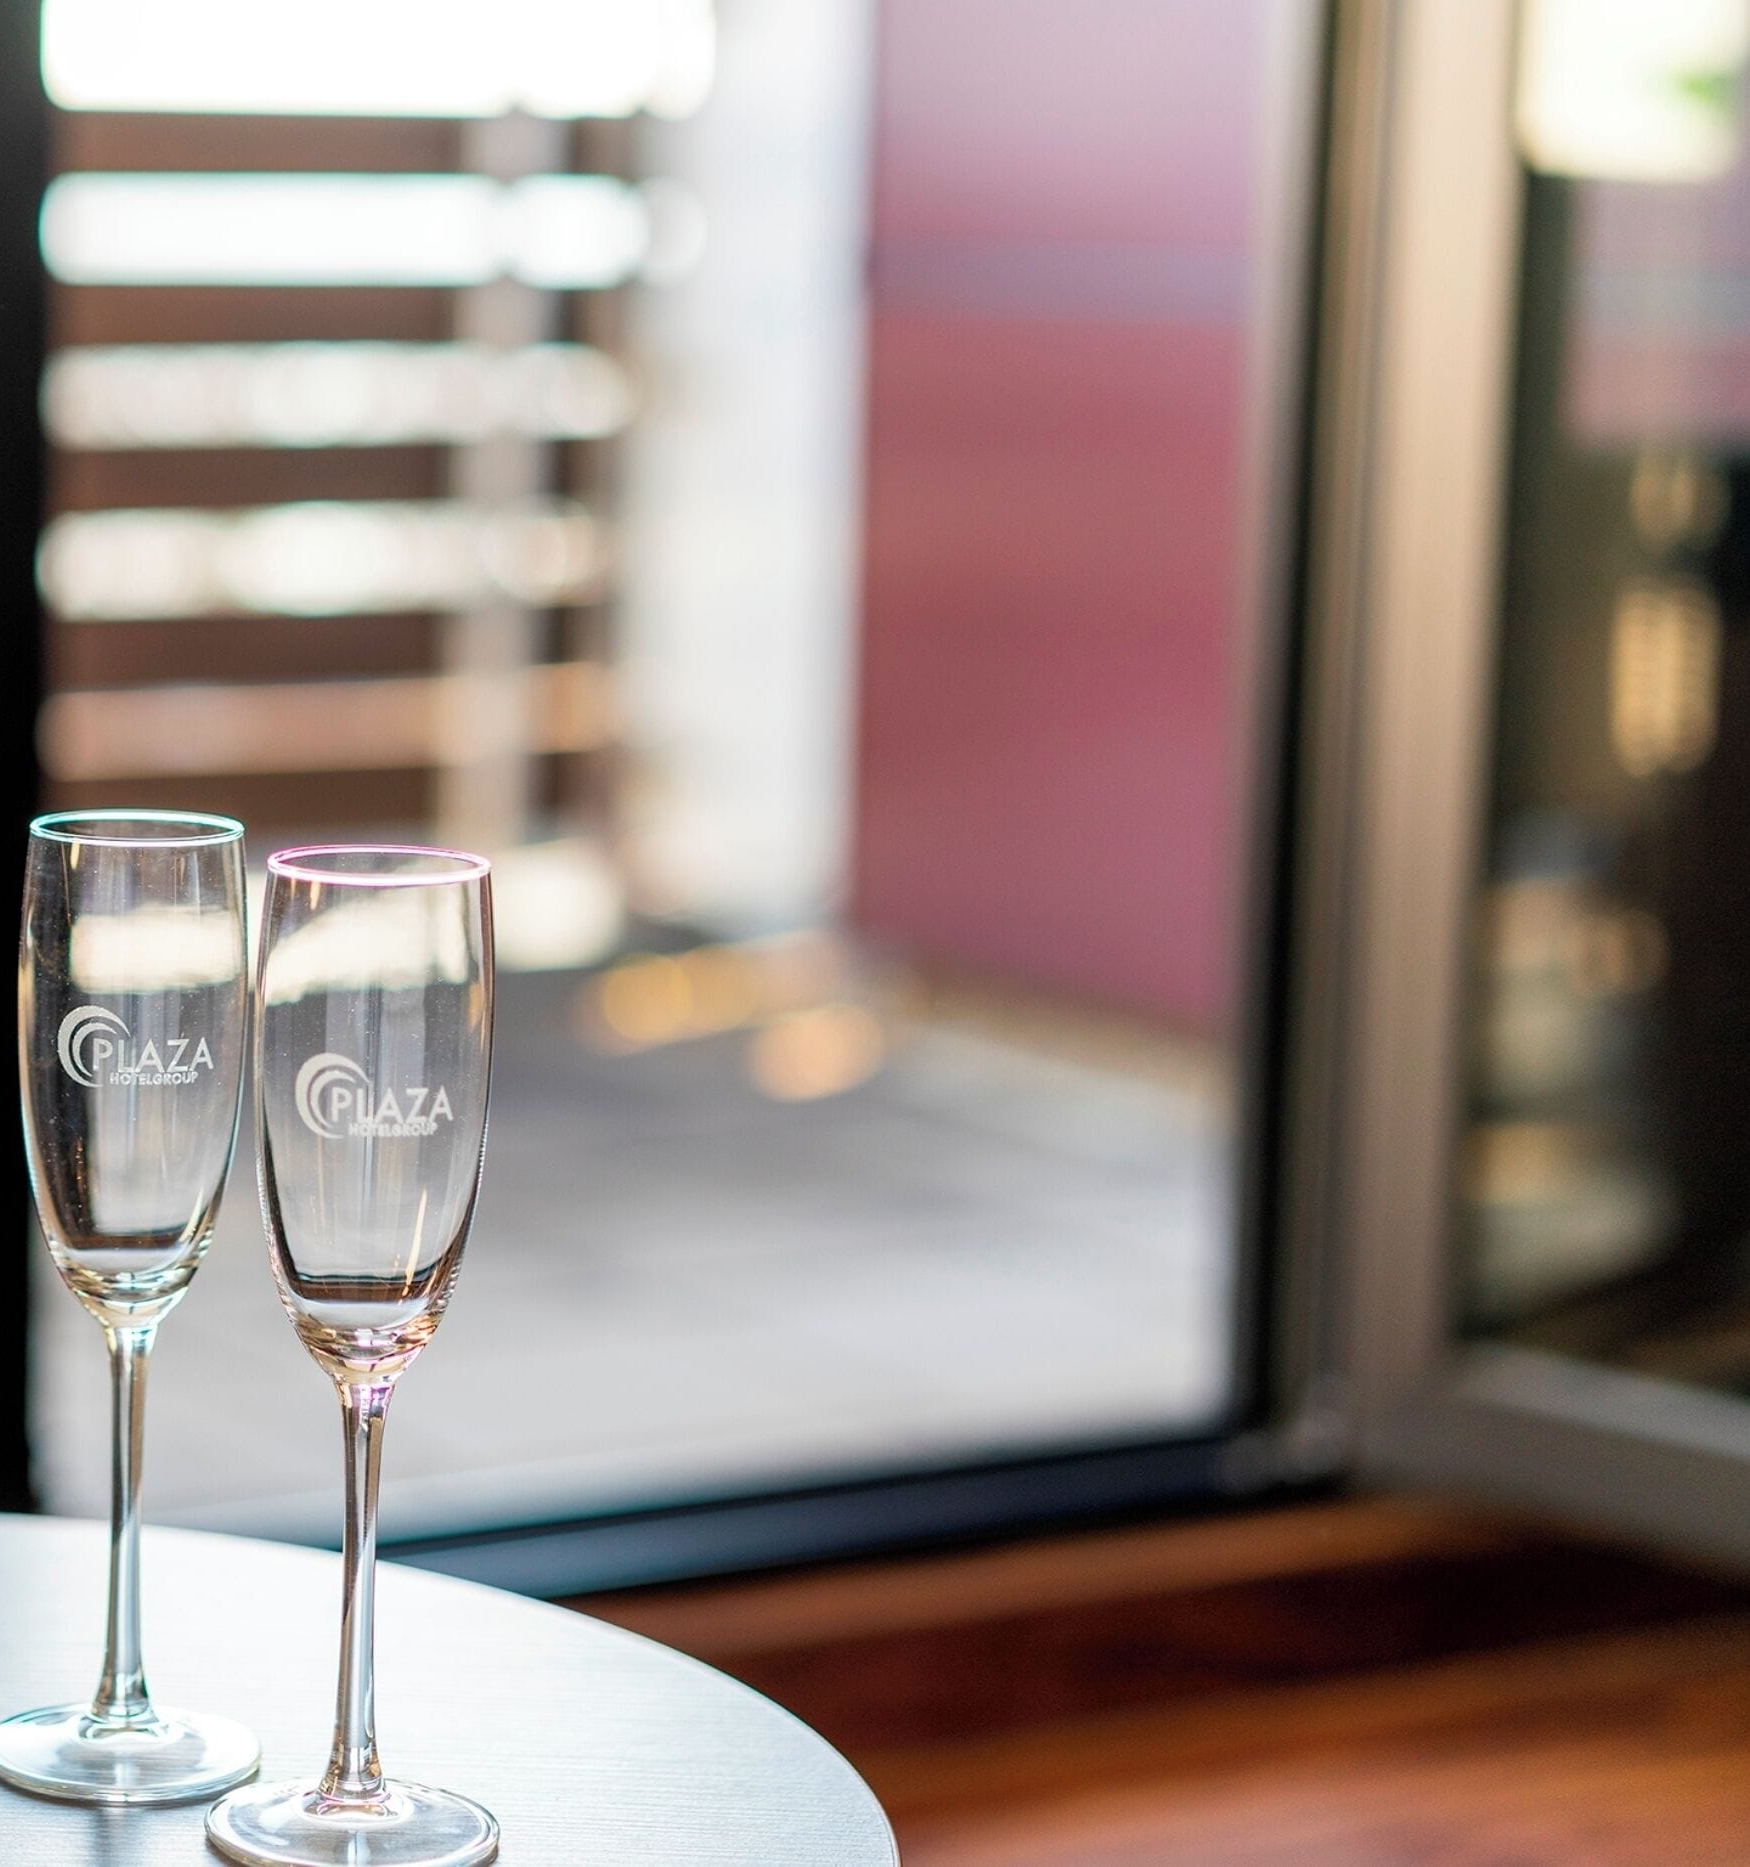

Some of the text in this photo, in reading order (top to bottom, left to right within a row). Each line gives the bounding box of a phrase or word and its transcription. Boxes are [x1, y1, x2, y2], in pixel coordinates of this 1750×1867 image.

[92, 1036, 215, 1073] PLAZA
[110, 1071, 199, 1086] HOTELGROUP
[331, 1085, 454, 1123] PLAZA
[348, 1121, 439, 1137] HOTELGROUP
